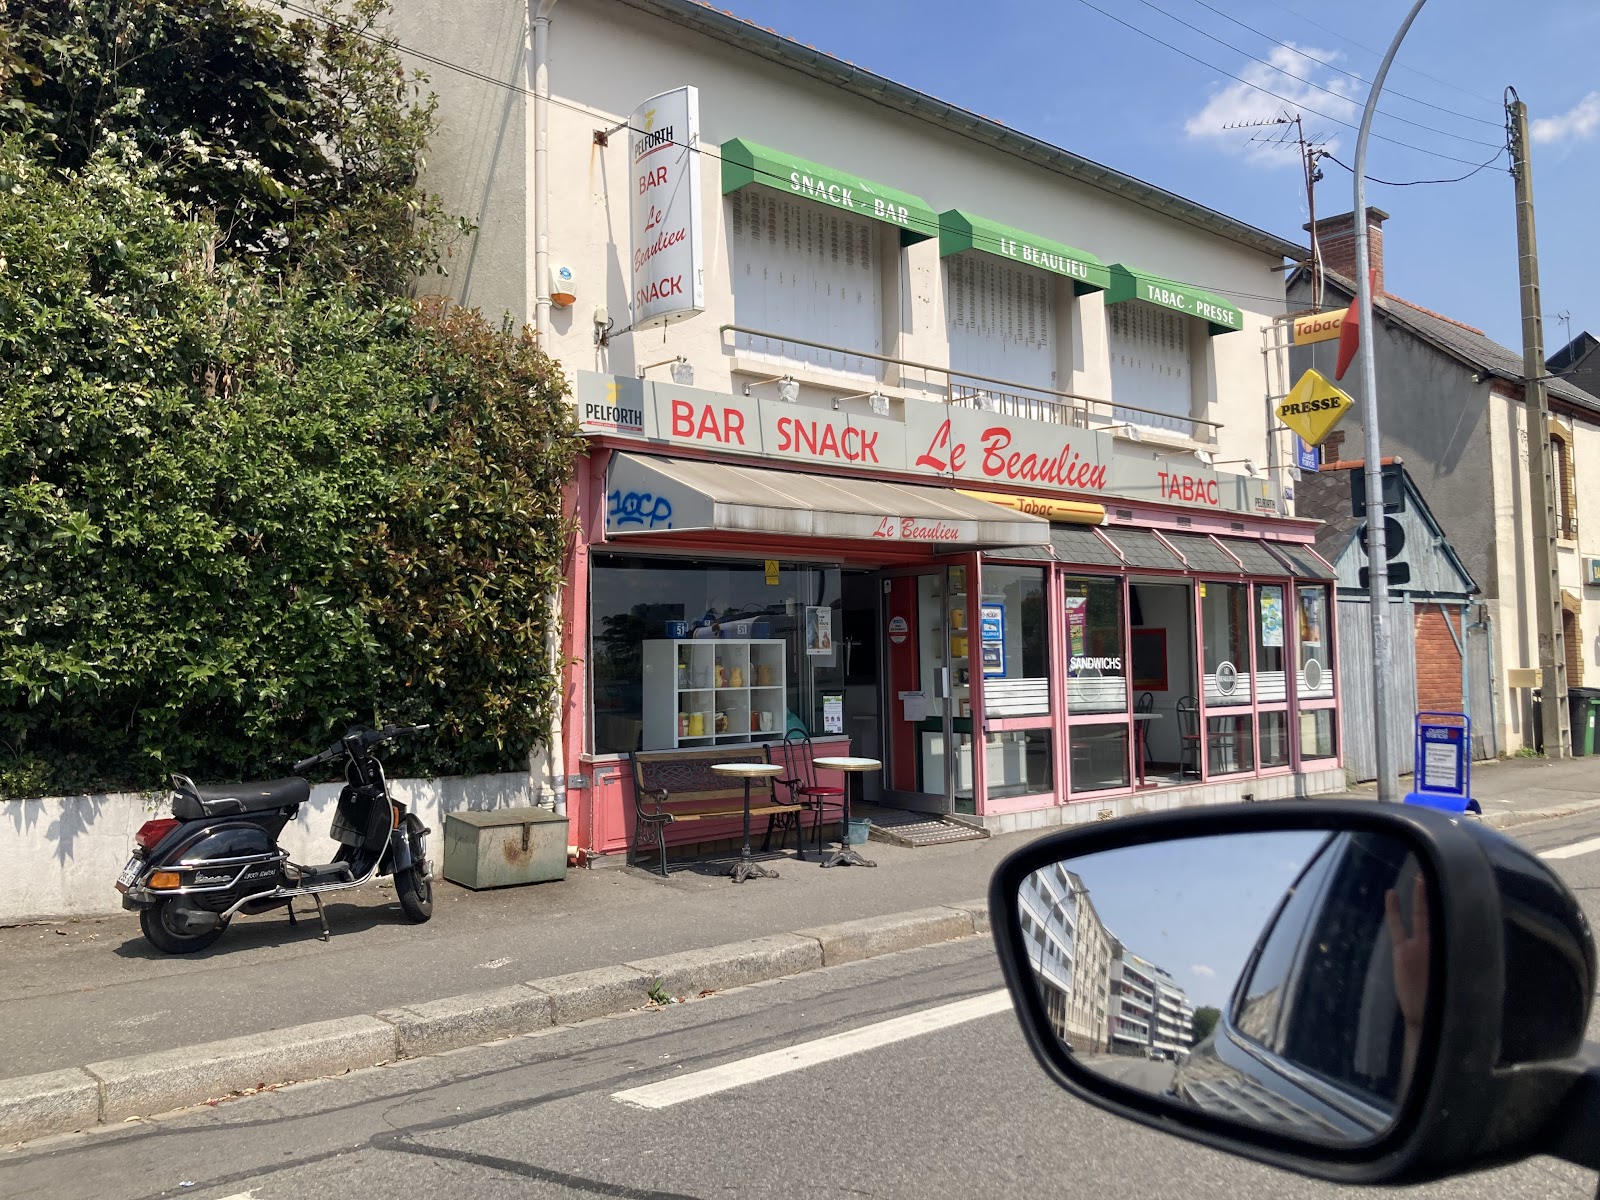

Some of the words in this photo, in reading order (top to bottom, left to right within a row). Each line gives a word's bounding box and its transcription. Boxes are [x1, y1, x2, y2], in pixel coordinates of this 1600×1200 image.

[635, 125, 674, 159] PELFORTH
[639, 165, 668, 195] BAR
[790, 172, 853, 208] SNACK
[874, 198, 908, 224] BAR
[644, 205, 662, 233] Le
[634, 227, 686, 273] Beaulieu
[1001, 237, 1017, 257] LE
[1023, 244, 1087, 278] BEAULIEU
[636, 275, 683, 305] SNACK
[1147, 285, 1185, 308] TABAC
[1196, 301, 1234, 324] PRESSE
[1295, 317, 1341, 336] Tabac
[585, 403, 642, 426] PELFORTH
[1281, 396, 1341, 417] PRESSE
[671, 399, 746, 446] BAR
[777, 417, 880, 463] SNACK
[915, 418, 967, 472] Le
[980, 427, 1108, 490] Beaulieu
[1157, 471, 1219, 505] TABAC
[1015, 497, 1054, 517] Tabac
[873, 516, 895, 538] Le
[900, 517, 960, 540] Beaulieu
[676, 625, 685, 635] 51
[1070, 656, 1122, 670] SANDWICHS
